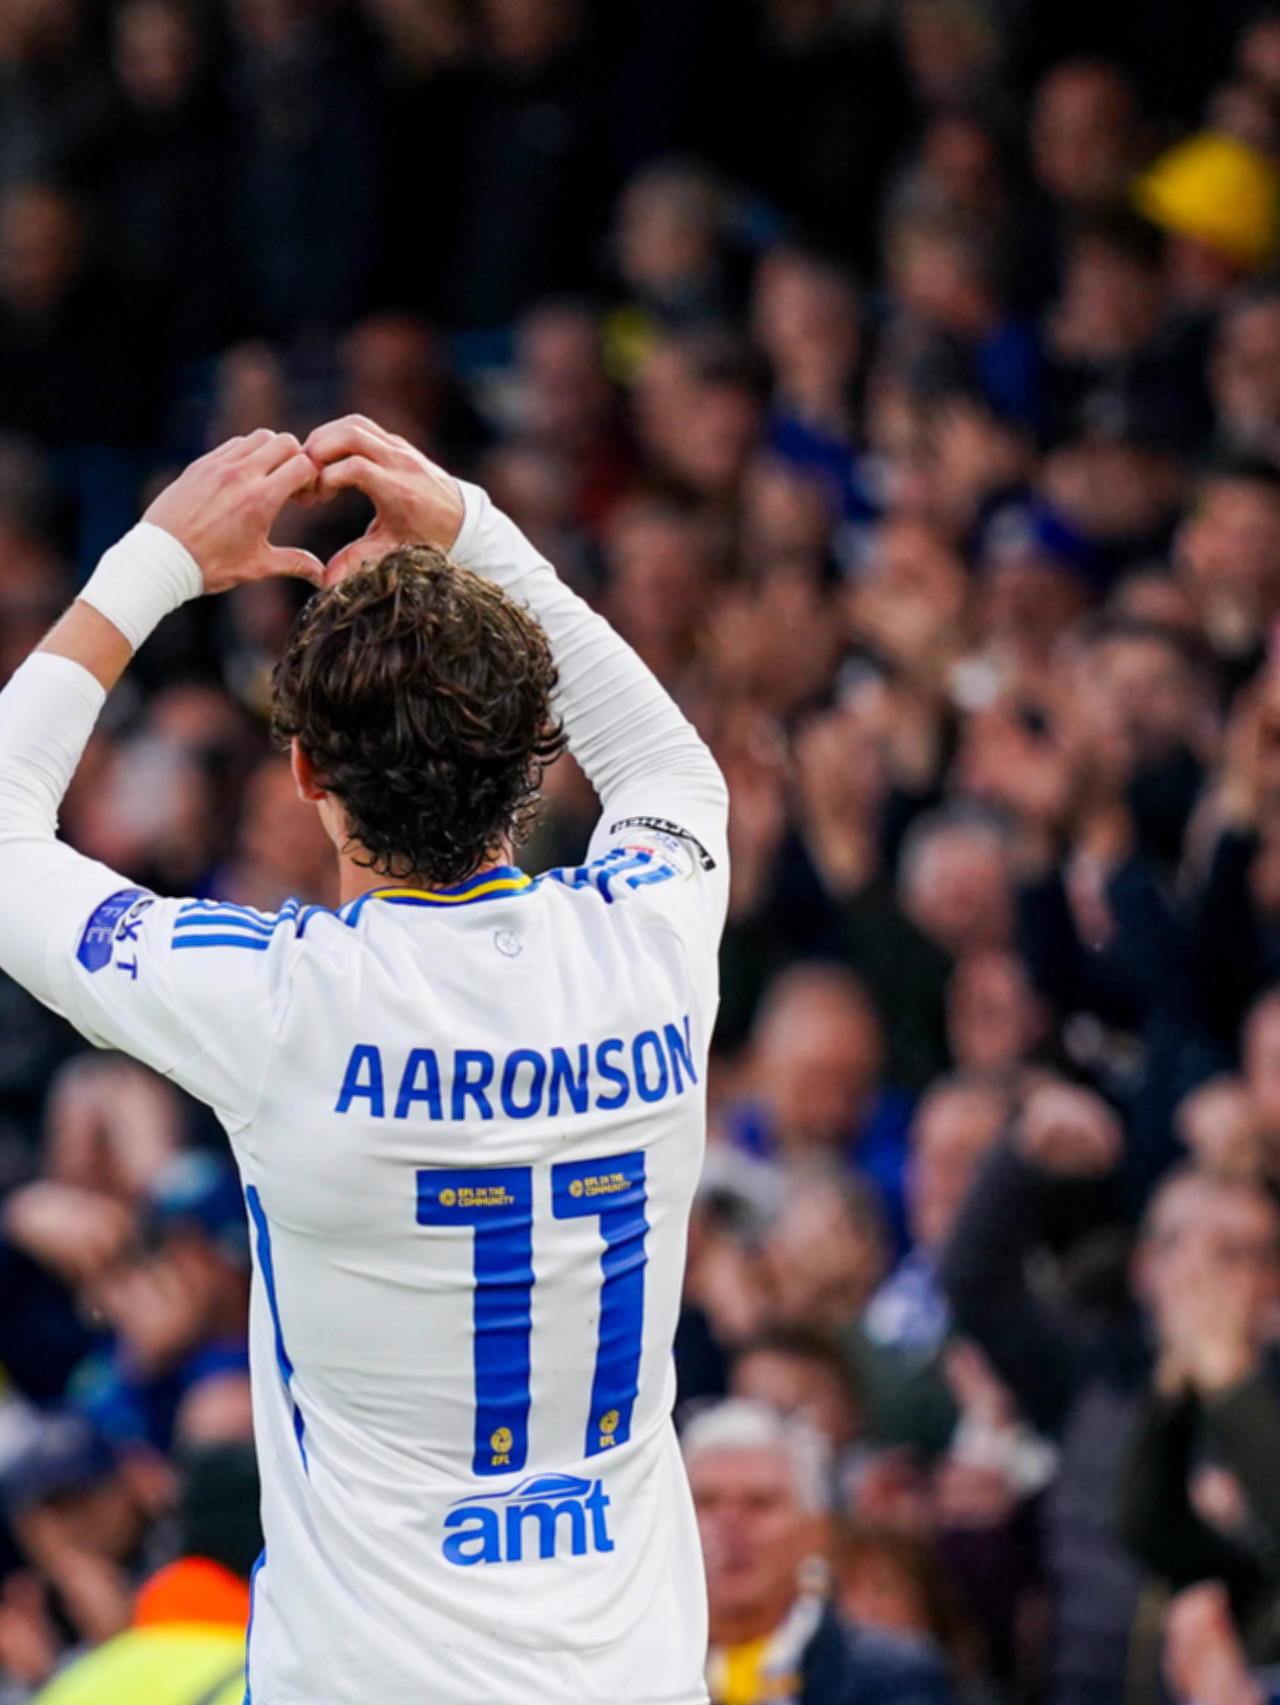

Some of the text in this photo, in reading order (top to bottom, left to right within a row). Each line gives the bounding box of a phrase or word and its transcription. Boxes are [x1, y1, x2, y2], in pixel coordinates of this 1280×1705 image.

[334, 1015, 698, 1120] AARONSON
[489, 1186, 505, 1196] THE
[458, 1196, 515, 1207] COMMUNITY
[416, 1151, 650, 1476] 11
[600, 1435, 616, 1448] EFL
[490, 1454, 511, 1466] EFL
[441, 1479, 616, 1567] amt
